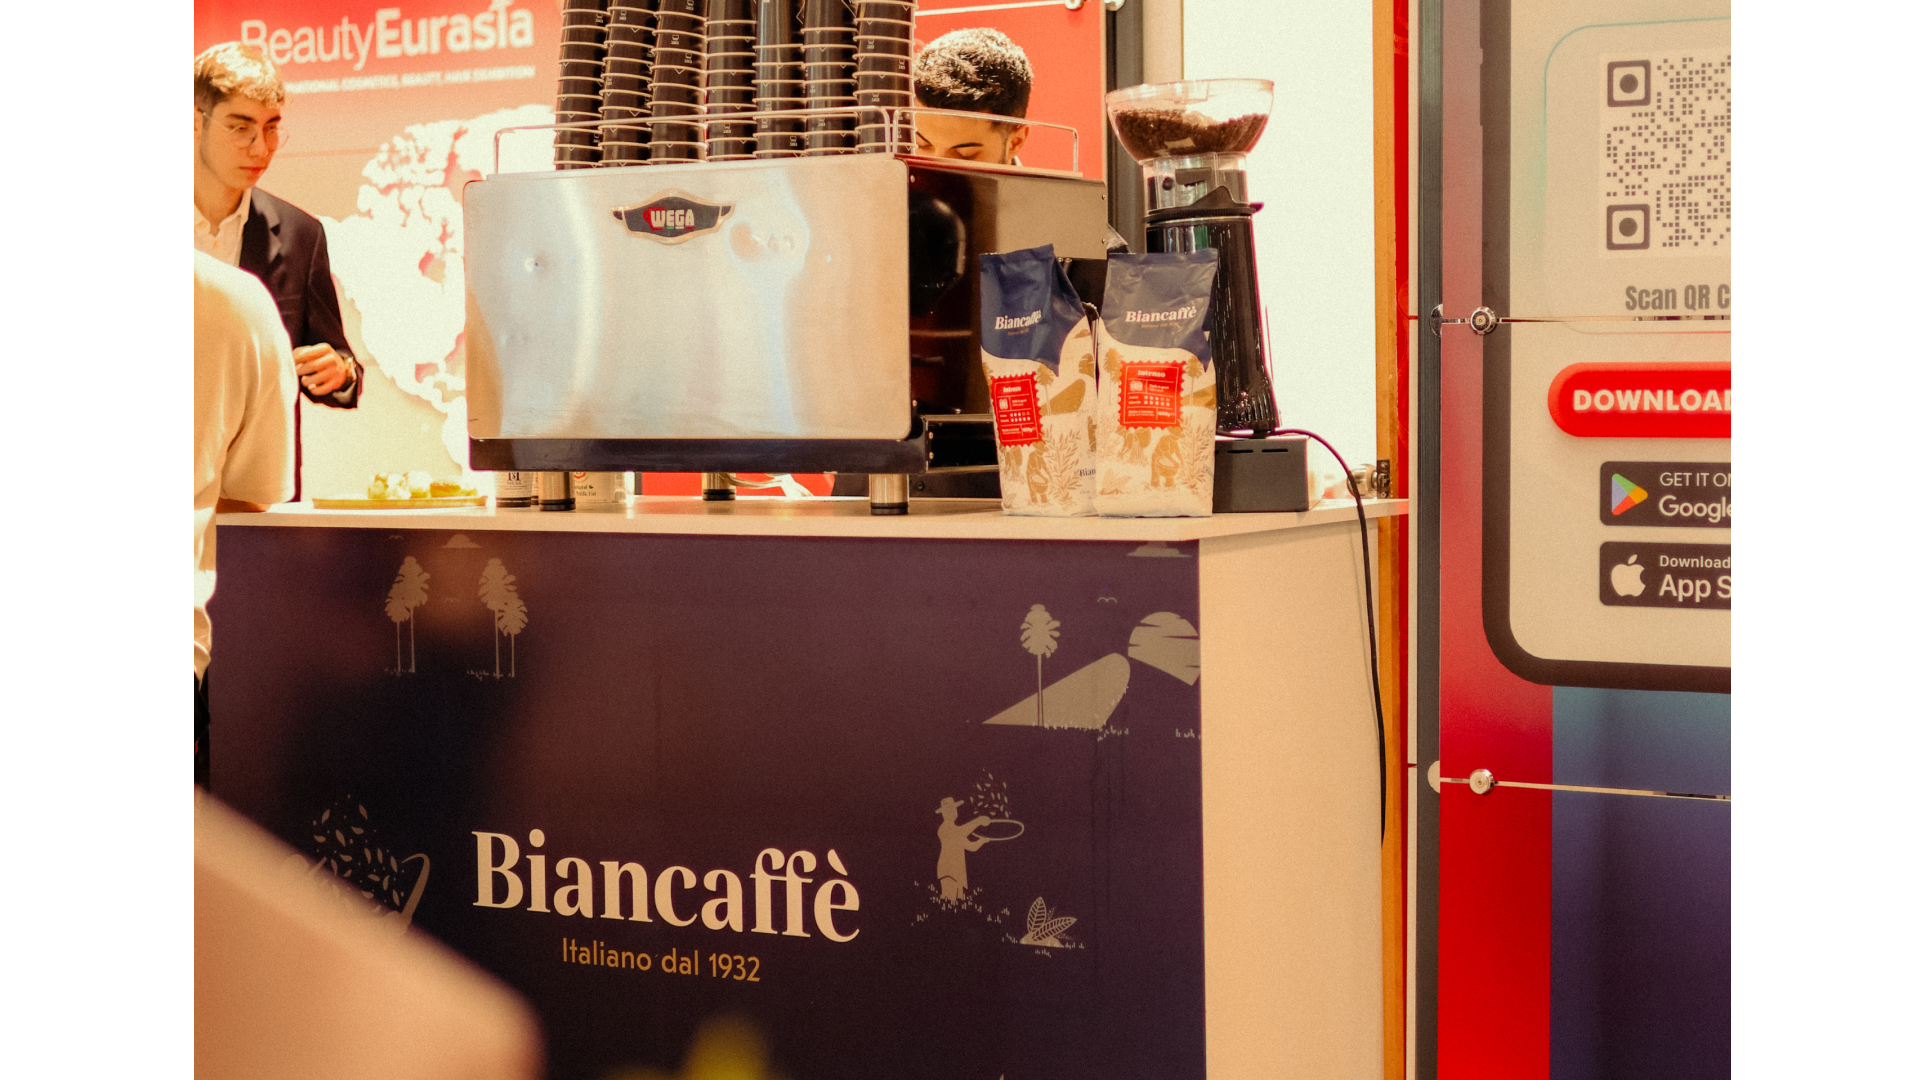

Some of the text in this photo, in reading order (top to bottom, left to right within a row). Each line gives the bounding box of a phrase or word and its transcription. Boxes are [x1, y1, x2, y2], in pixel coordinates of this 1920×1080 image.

[650, 209, 695, 228] WEGA
[1625, 284, 1677, 311] Scan
[1684, 284, 1710, 311] QR
[1124, 306, 1198, 323] Biancaffè
[1137, 370, 1166, 378] Intenso
[1660, 472, 1731, 487] GET IT O
[1660, 555, 1731, 569] Download
[1659, 574, 1711, 602] App
[471, 828, 860, 944] Biancaffè
[562, 937, 761, 983] Italiano dal 1932
